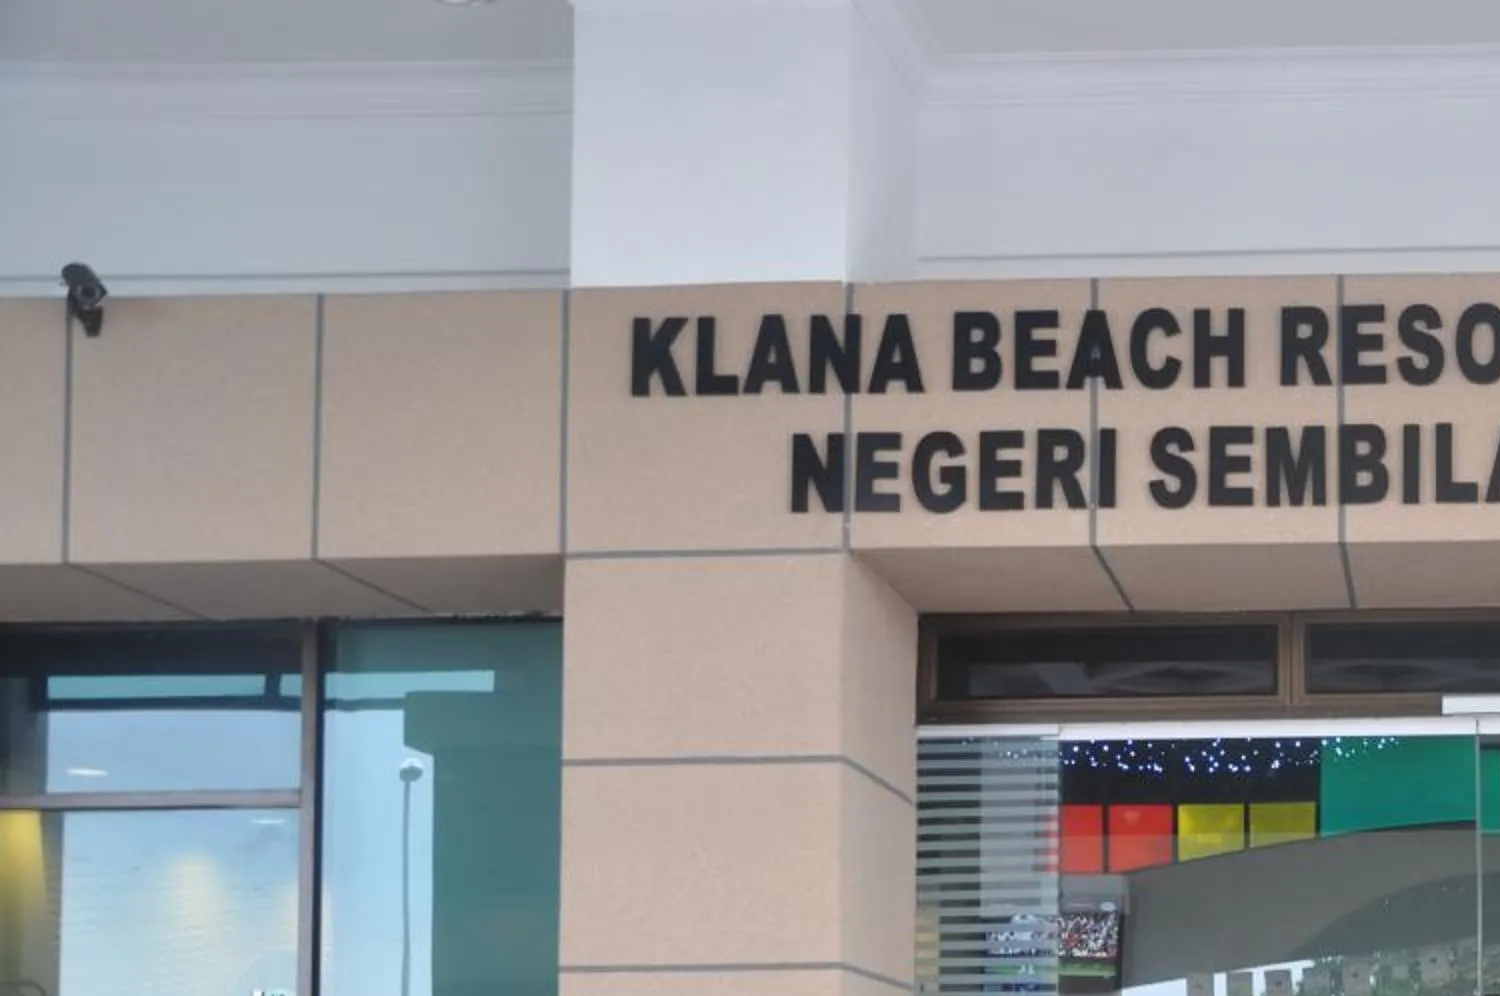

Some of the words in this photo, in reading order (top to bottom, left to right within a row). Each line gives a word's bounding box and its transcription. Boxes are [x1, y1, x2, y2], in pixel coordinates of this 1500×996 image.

[632, 314, 923, 395] KLANA
[953, 309, 1244, 390] BEACH
[792, 429, 1115, 512] NEGERI
